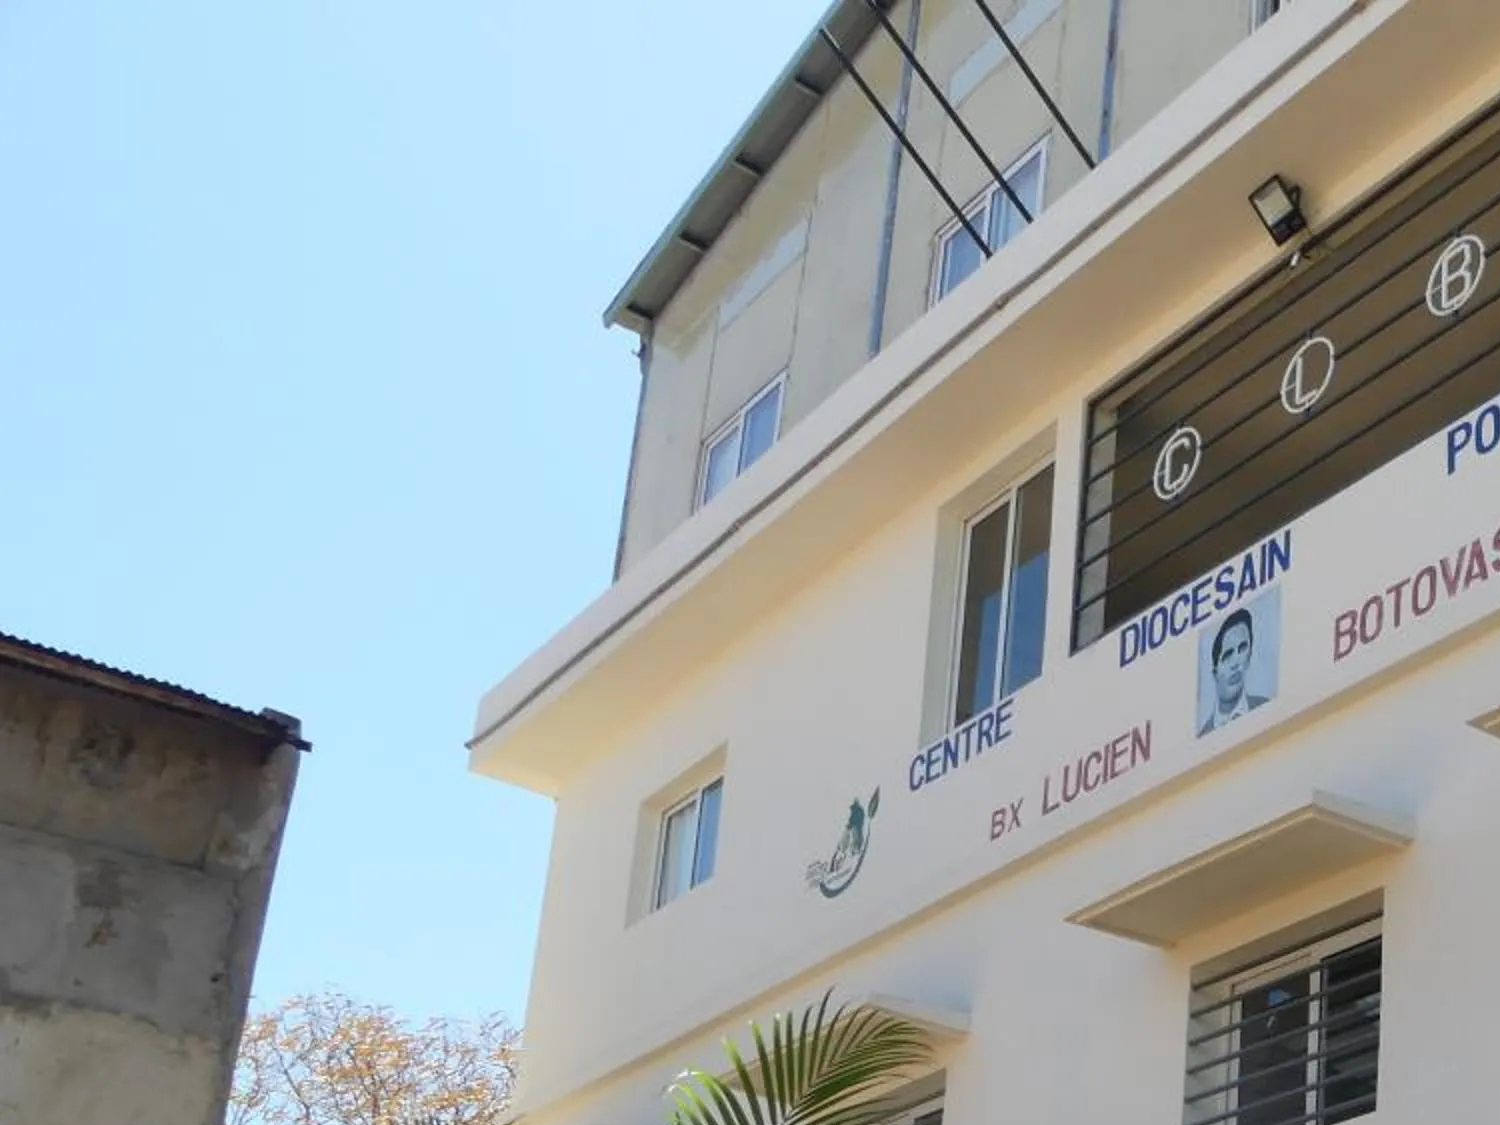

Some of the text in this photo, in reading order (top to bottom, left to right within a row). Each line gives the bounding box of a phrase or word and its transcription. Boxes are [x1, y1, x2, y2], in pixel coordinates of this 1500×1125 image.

[909, 698, 1014, 792] CENTRE
[1119, 529, 1292, 669] DIOCESAIN
[990, 798, 1024, 842] BX
[1041, 720, 1153, 815] LUCIEN
